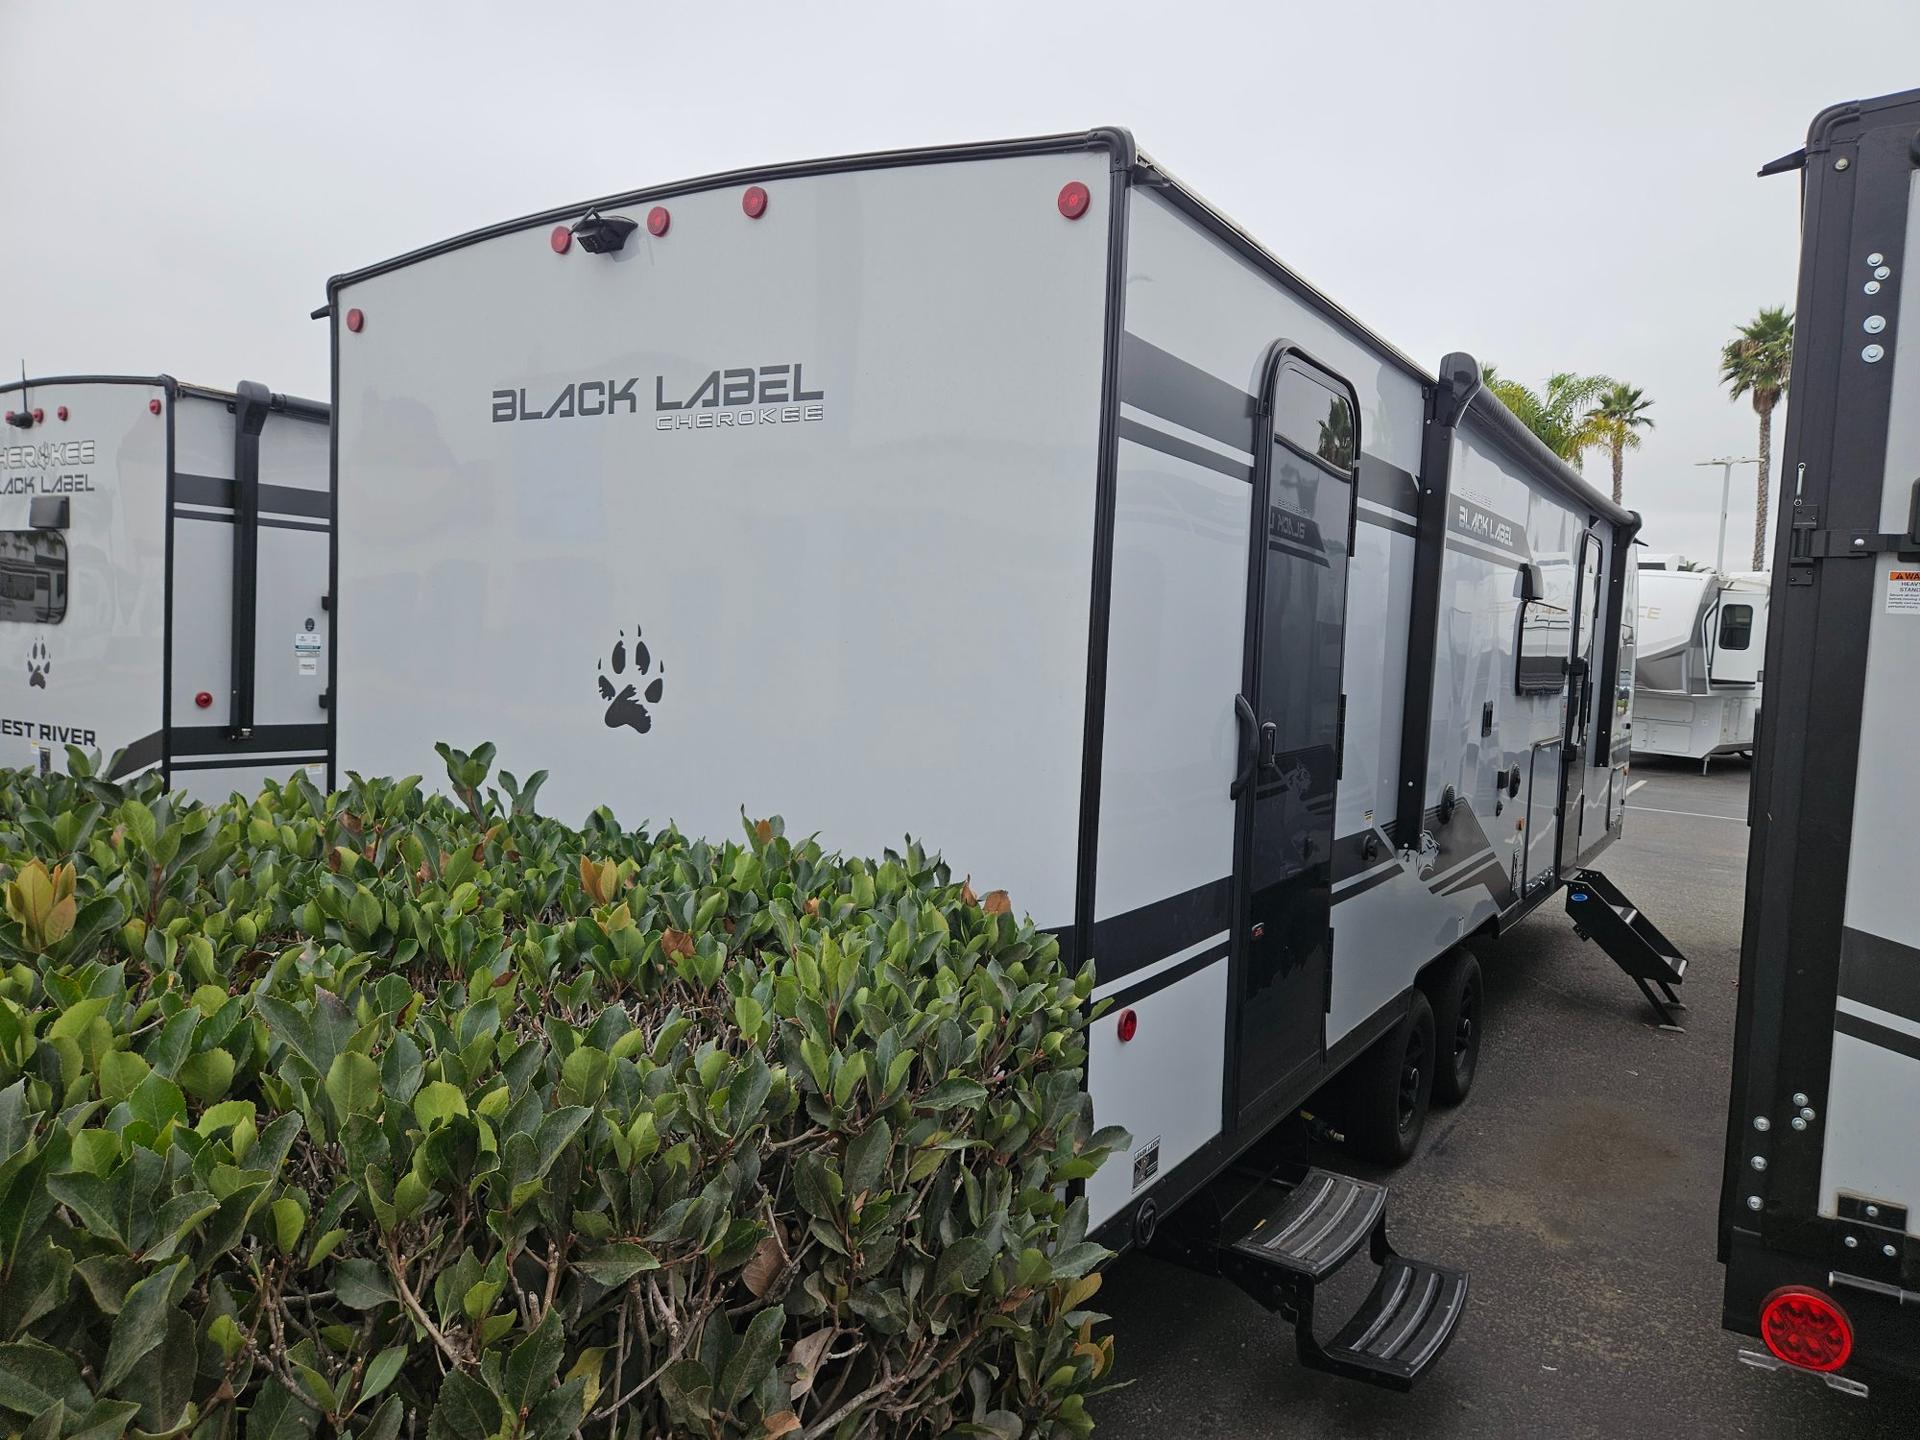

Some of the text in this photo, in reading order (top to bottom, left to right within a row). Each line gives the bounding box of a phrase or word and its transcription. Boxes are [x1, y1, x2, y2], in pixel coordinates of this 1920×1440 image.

[492, 363, 824, 423] BLACK LABEL
[656, 404, 824, 431] CHEROKEE
[41, 474, 95, 493] LABEL
[1459, 505, 1513, 547] BLACK LABEL
[39, 724, 96, 747] RIVER
